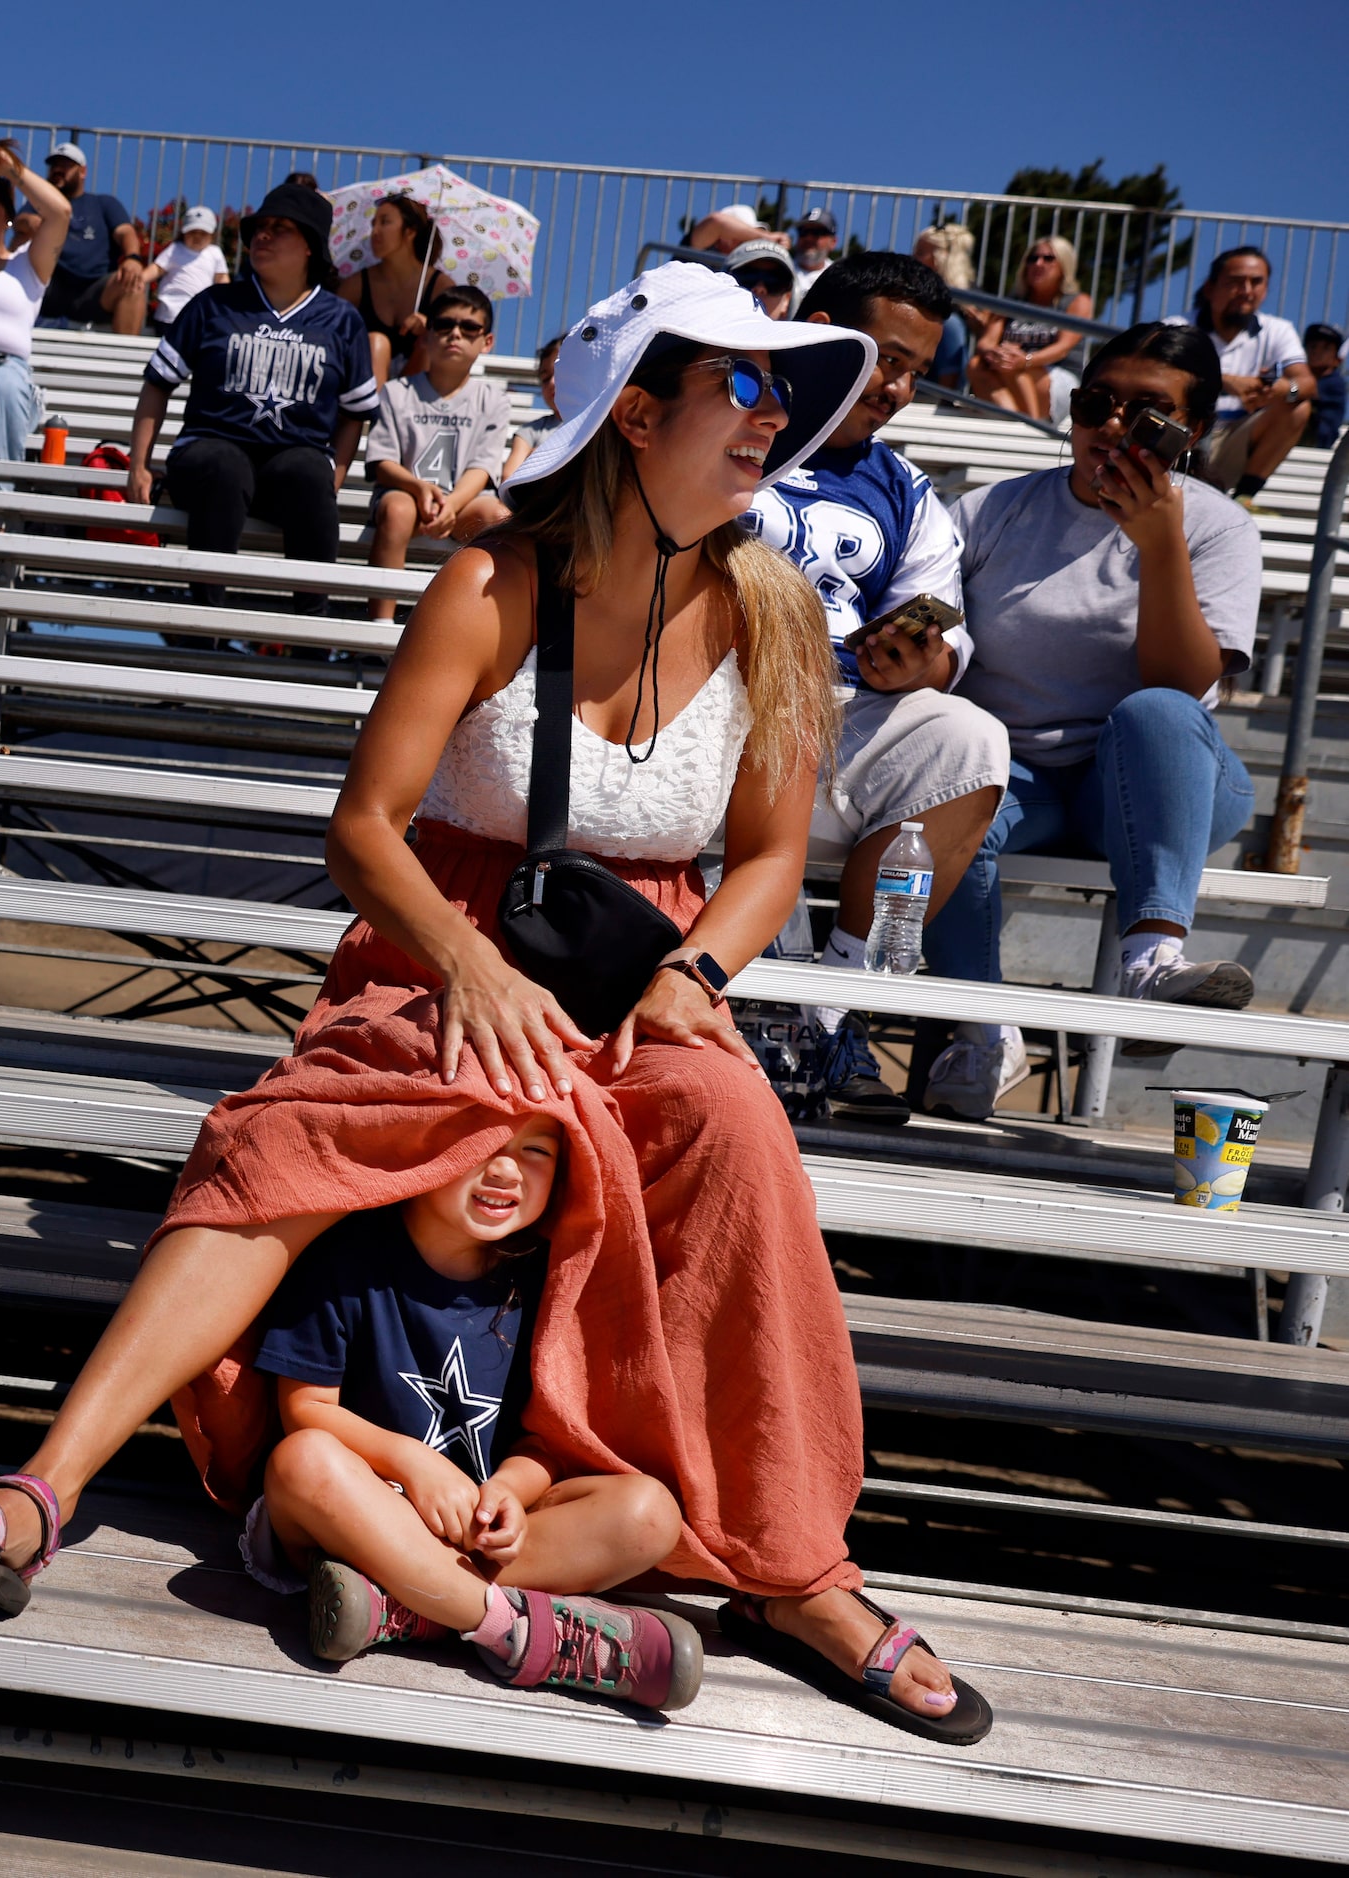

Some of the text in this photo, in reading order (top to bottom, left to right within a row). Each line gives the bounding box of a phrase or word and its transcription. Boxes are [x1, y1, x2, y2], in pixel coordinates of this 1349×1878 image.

[254, 323, 304, 343] Dallas
[224, 332, 327, 404] COWBOYS
[413, 414, 472, 427] COWBOYS
[413, 428, 460, 494] 4
